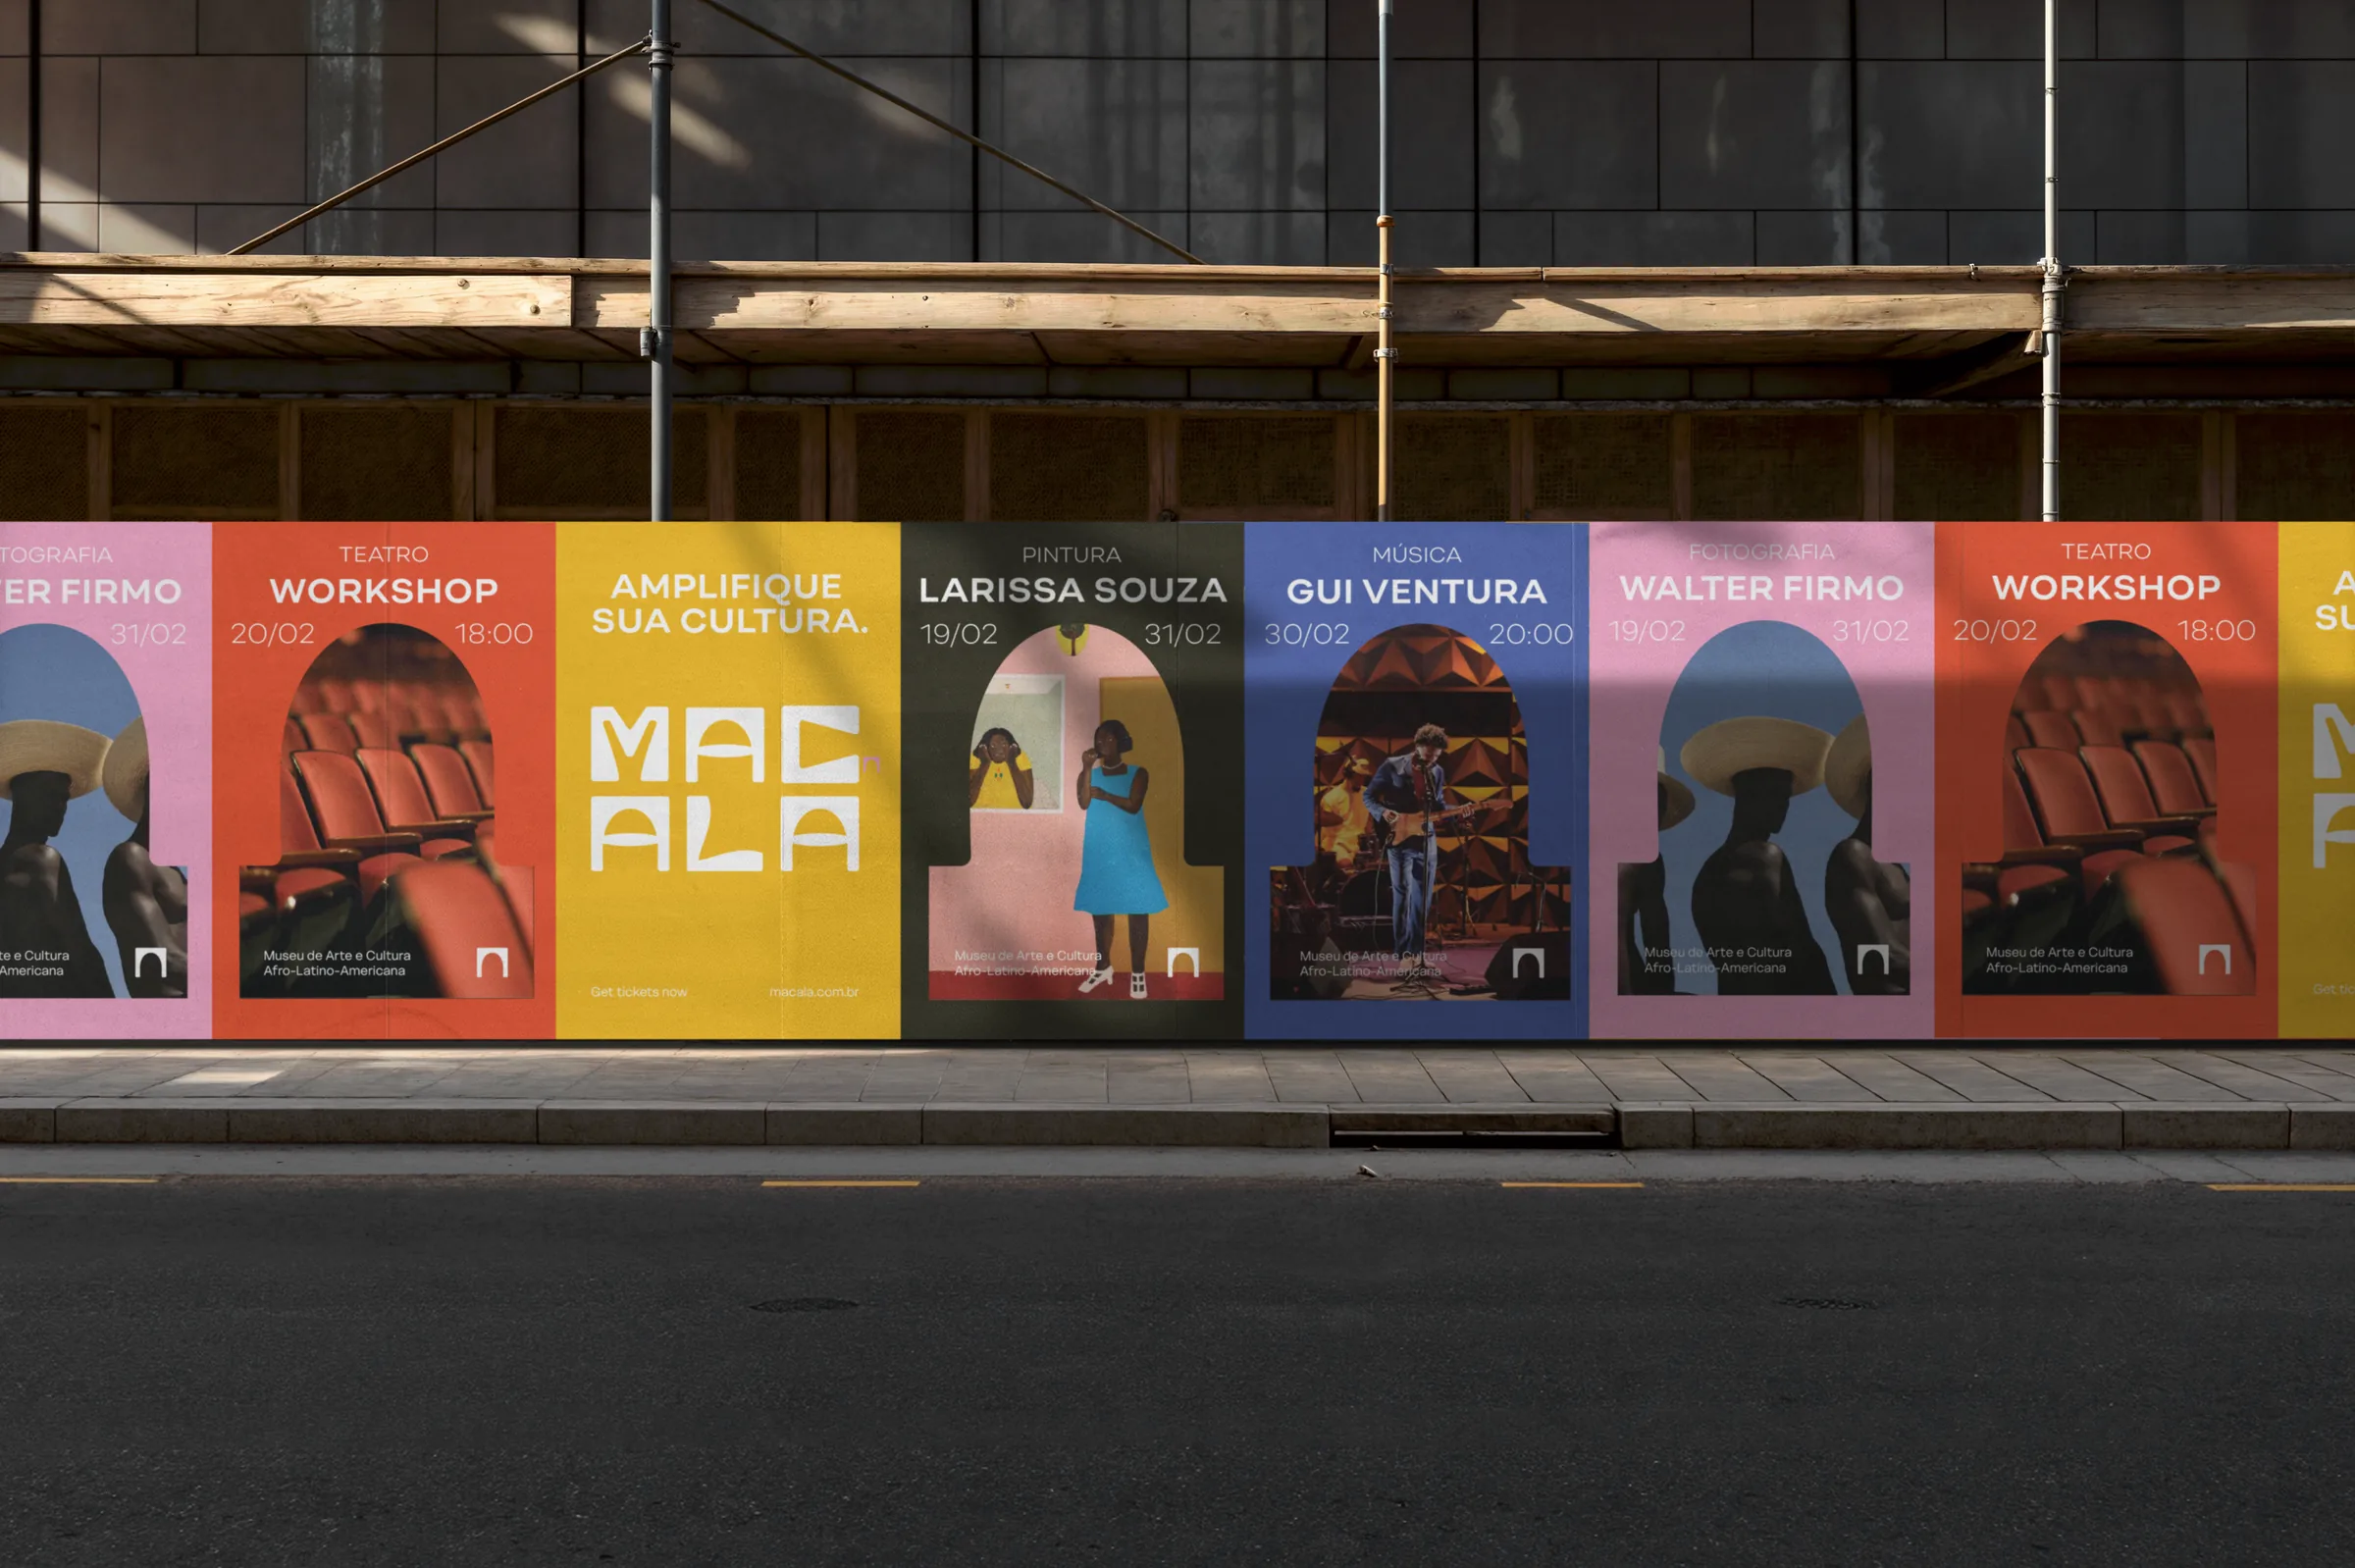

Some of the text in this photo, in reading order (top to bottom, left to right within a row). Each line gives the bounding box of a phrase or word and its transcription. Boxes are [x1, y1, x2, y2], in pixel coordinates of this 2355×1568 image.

[339, 547, 429, 562] TEATRO
[1022, 547, 1122, 563] PINTURA
[1373, 543, 1462, 563] MÚSICA
[1690, 544, 1835, 560] FOTOGRAFIA
[2062, 544, 2151, 559] TEATRO
[0, 579, 182, 604] ER FIRMO
[270, 578, 498, 603] WORKSHOP
[610, 574, 841, 605] AMPLIFIQUE
[919, 577, 1229, 603] LARISSA SOUZA
[1286, 579, 1547, 603] GUI VENTURA
[1619, 575, 1904, 601] WALTER FIRMO
[1992, 575, 2221, 601] WORKSHOP
[592, 608, 868, 634] SUA CULTURA.
[1608, 620, 1686, 644] 19/02
[1833, 620, 1910, 644] 31/02
[1954, 619, 2037, 644] 20/02
[2177, 619, 2256, 641] 18:00
[111, 623, 186, 648] 31/02
[231, 622, 315, 648] 20/02
[454, 622, 533, 645] 18:00
[919, 623, 998, 648] 19/02
[1144, 623, 1223, 648] 31/02
[1265, 623, 1350, 648] 30/02
[1490, 623, 1574, 645] 20:00
[591, 706, 860, 784] MAC
[591, 796, 860, 871] ALA
[14, 953, 22, 962] e
[25, 950, 70, 962] Cultura
[263, 950, 411, 962] Museu de Arte e Cultura
[955, 950, 1102, 962] Museu de Arte e Cultura
[1299, 951, 1447, 963] Museu de Arte e Cultura
[1645, 947, 1792, 959] Museu de Arte e Cultura
[1986, 947, 2134, 959] Museu de Arte e Cultura
[262, 965, 406, 976] Afro-Latino-Americana
[954, 966, 1097, 977] Afro-Latino-Americana
[1299, 966, 1442, 977] Afro-Latino-Americana
[1644, 963, 1787, 974] Afro-Latino-Americana
[1986, 963, 2128, 974] Afro-Latino-Americana
[591, 986, 688, 998] Get tickets now
[769, 986, 860, 998] macala.com.br
[2313, 983, 2336, 995] Get
